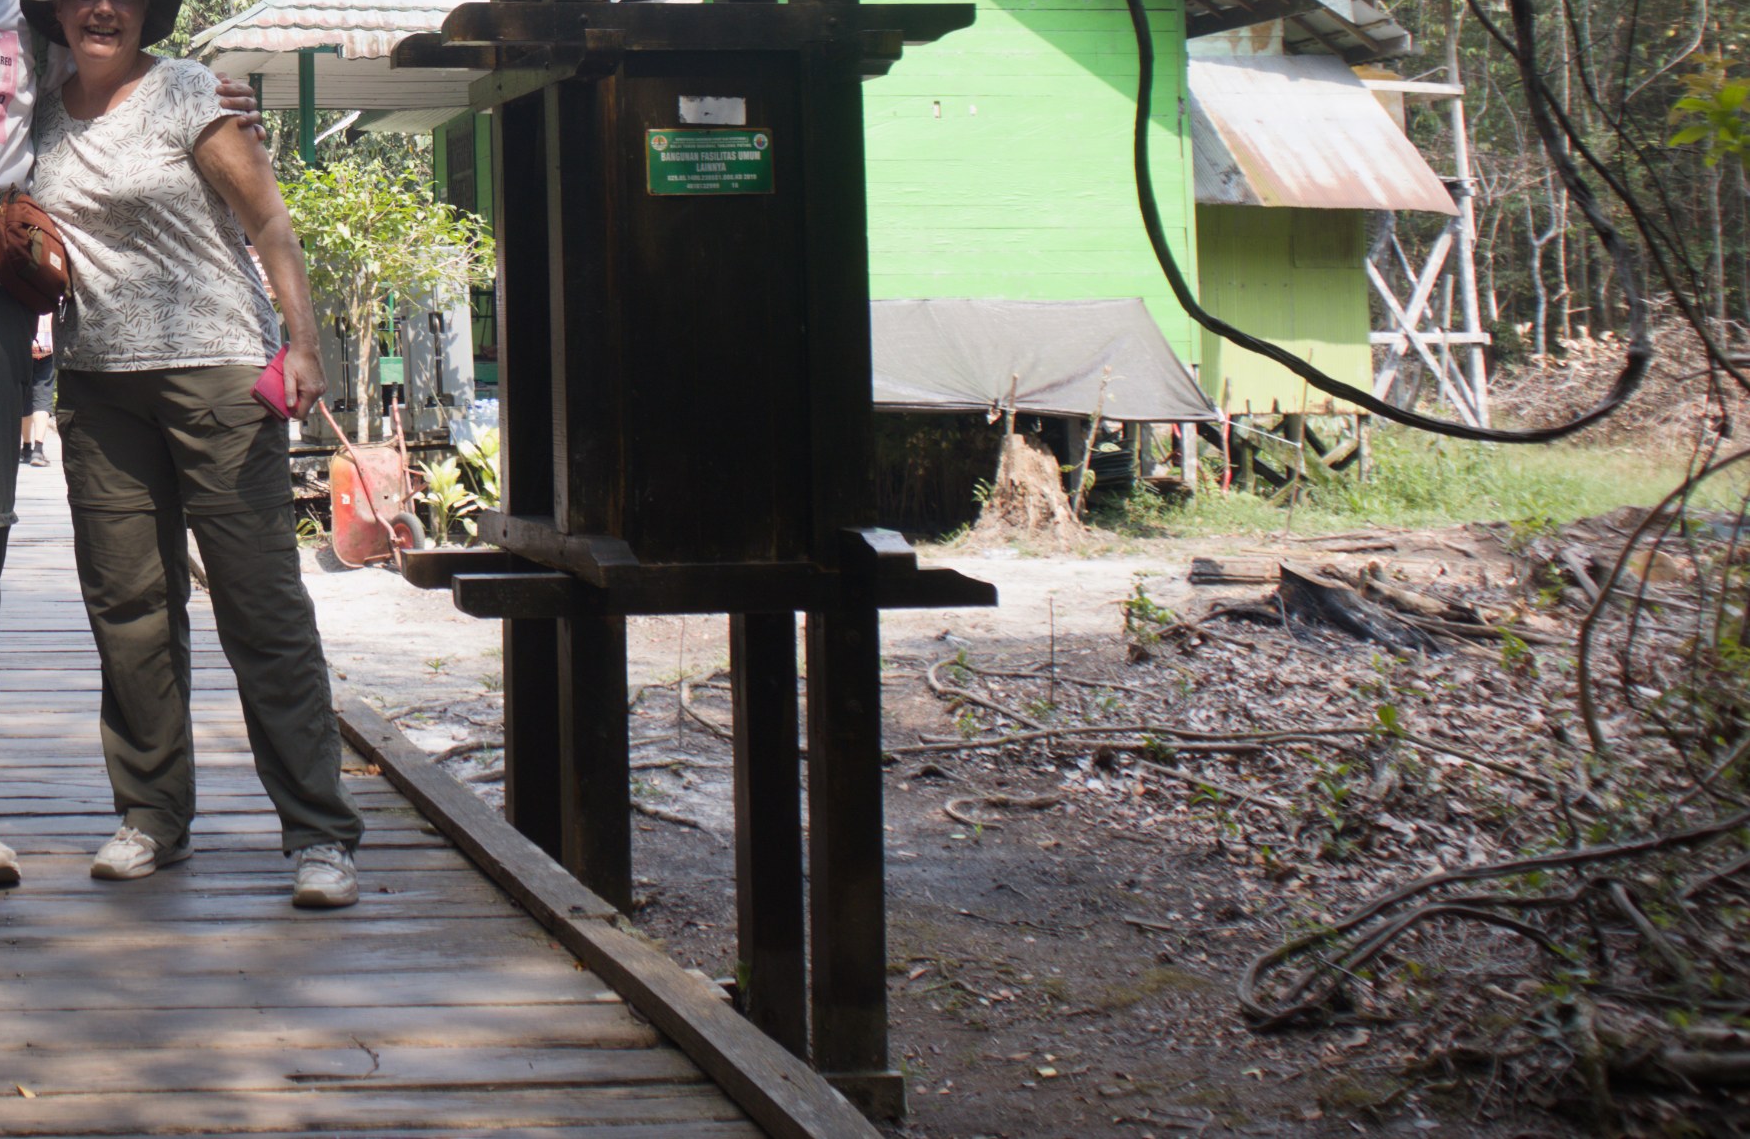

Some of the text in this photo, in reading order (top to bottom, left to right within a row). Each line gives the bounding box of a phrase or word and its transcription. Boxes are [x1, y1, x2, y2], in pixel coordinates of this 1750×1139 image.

[661, 150, 761, 162] BANGUNAN FASILITAS UMUM
[696, 162, 727, 172] LAINNYA
